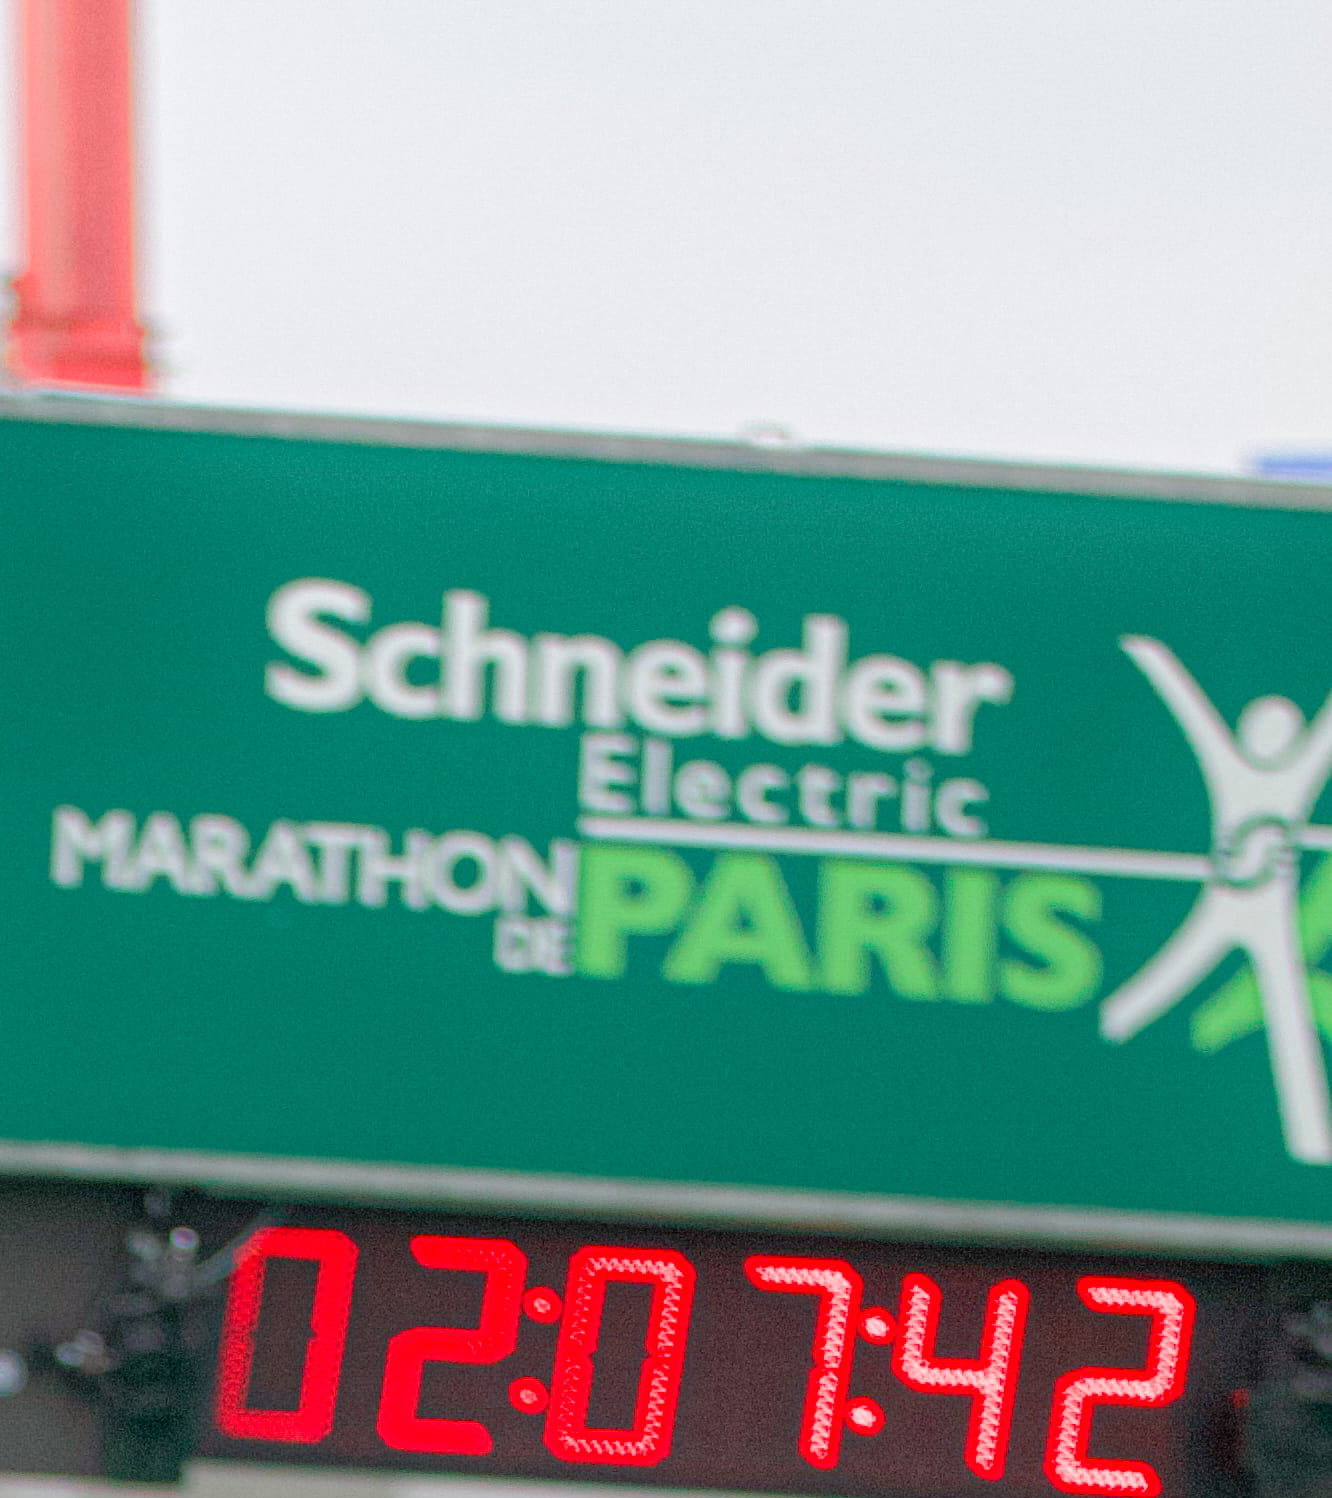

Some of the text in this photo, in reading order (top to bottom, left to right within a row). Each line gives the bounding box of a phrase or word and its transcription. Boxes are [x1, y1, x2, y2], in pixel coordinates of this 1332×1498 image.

[263, 576, 1014, 754] Schneider
[577, 732, 990, 838] Electric
[50, 805, 577, 920] MARATHON
[494, 917, 574, 977] DE
[577, 843, 1105, 1013] PARIS
